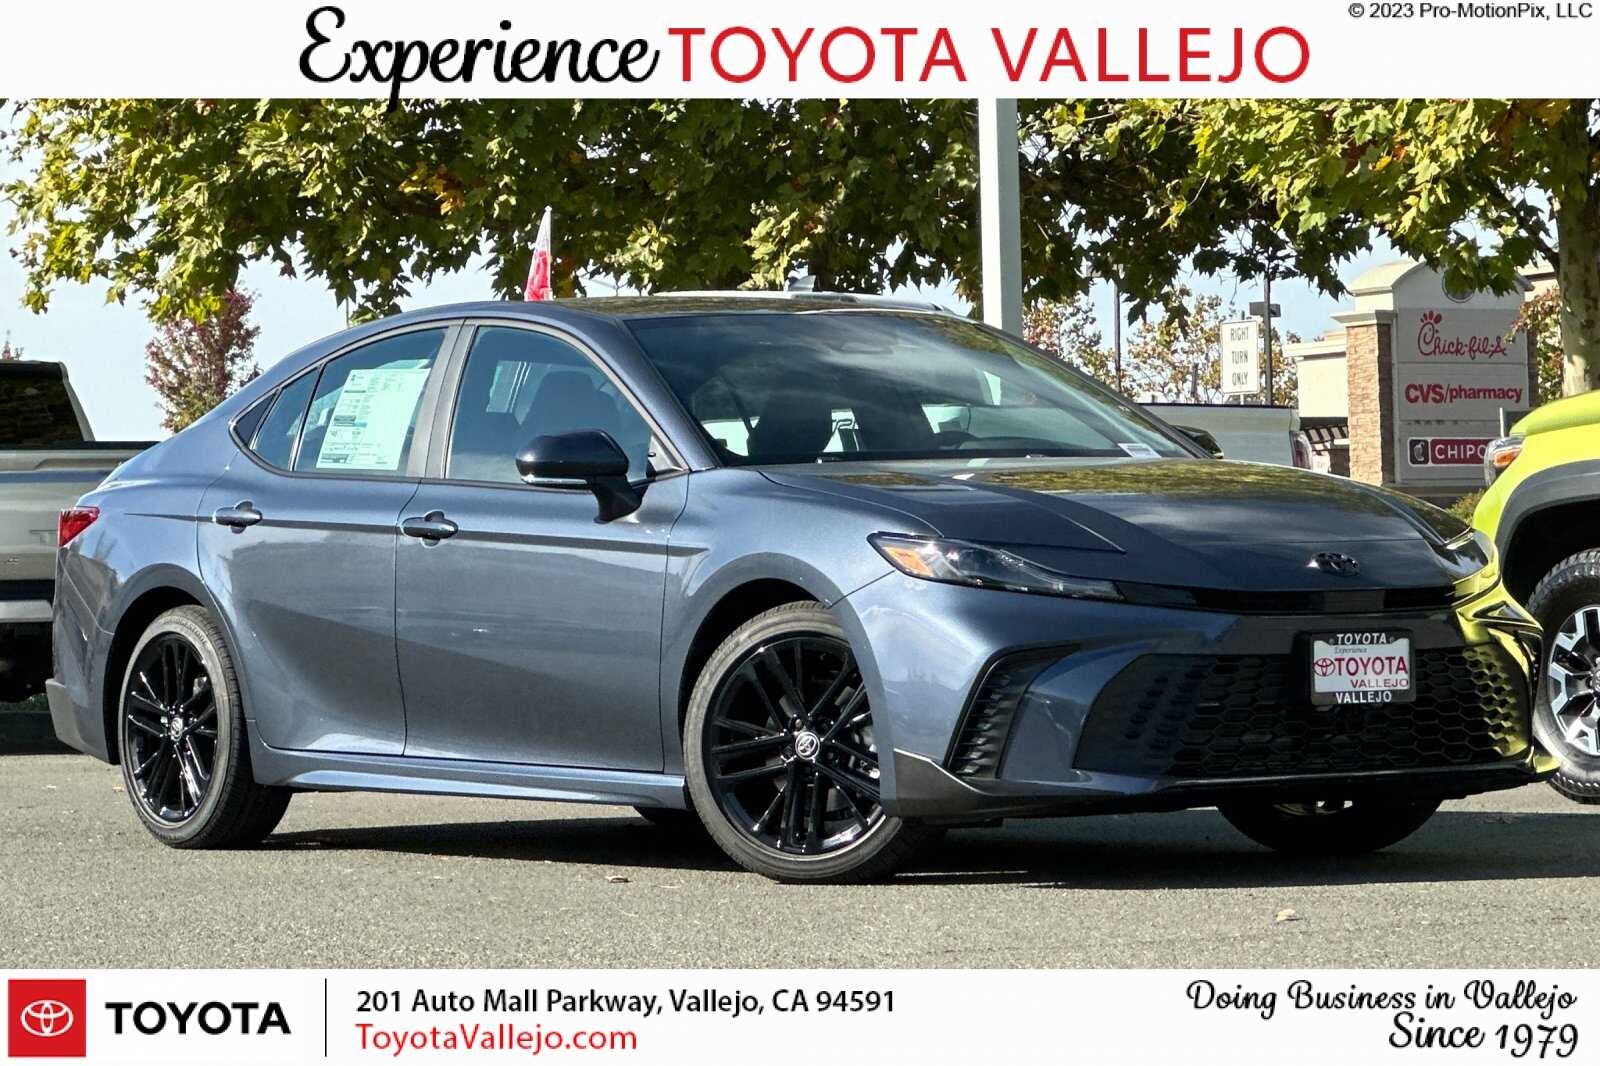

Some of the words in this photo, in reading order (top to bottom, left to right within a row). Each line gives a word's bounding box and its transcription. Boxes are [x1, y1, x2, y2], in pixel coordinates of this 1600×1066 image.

[1230, 326, 1249, 341] RIGHT
[1232, 350, 1249, 365] TURN
[1231, 371, 1249, 386] ONLY
[1405, 383, 1523, 404] CVS/pharmacy
[1336, 633, 1388, 645] TOYOTA
[1335, 656, 1409, 676] TOYOTA
[1350, 679, 1409, 689] VALLEJO
[1335, 691, 1392, 704] VALLEJO
